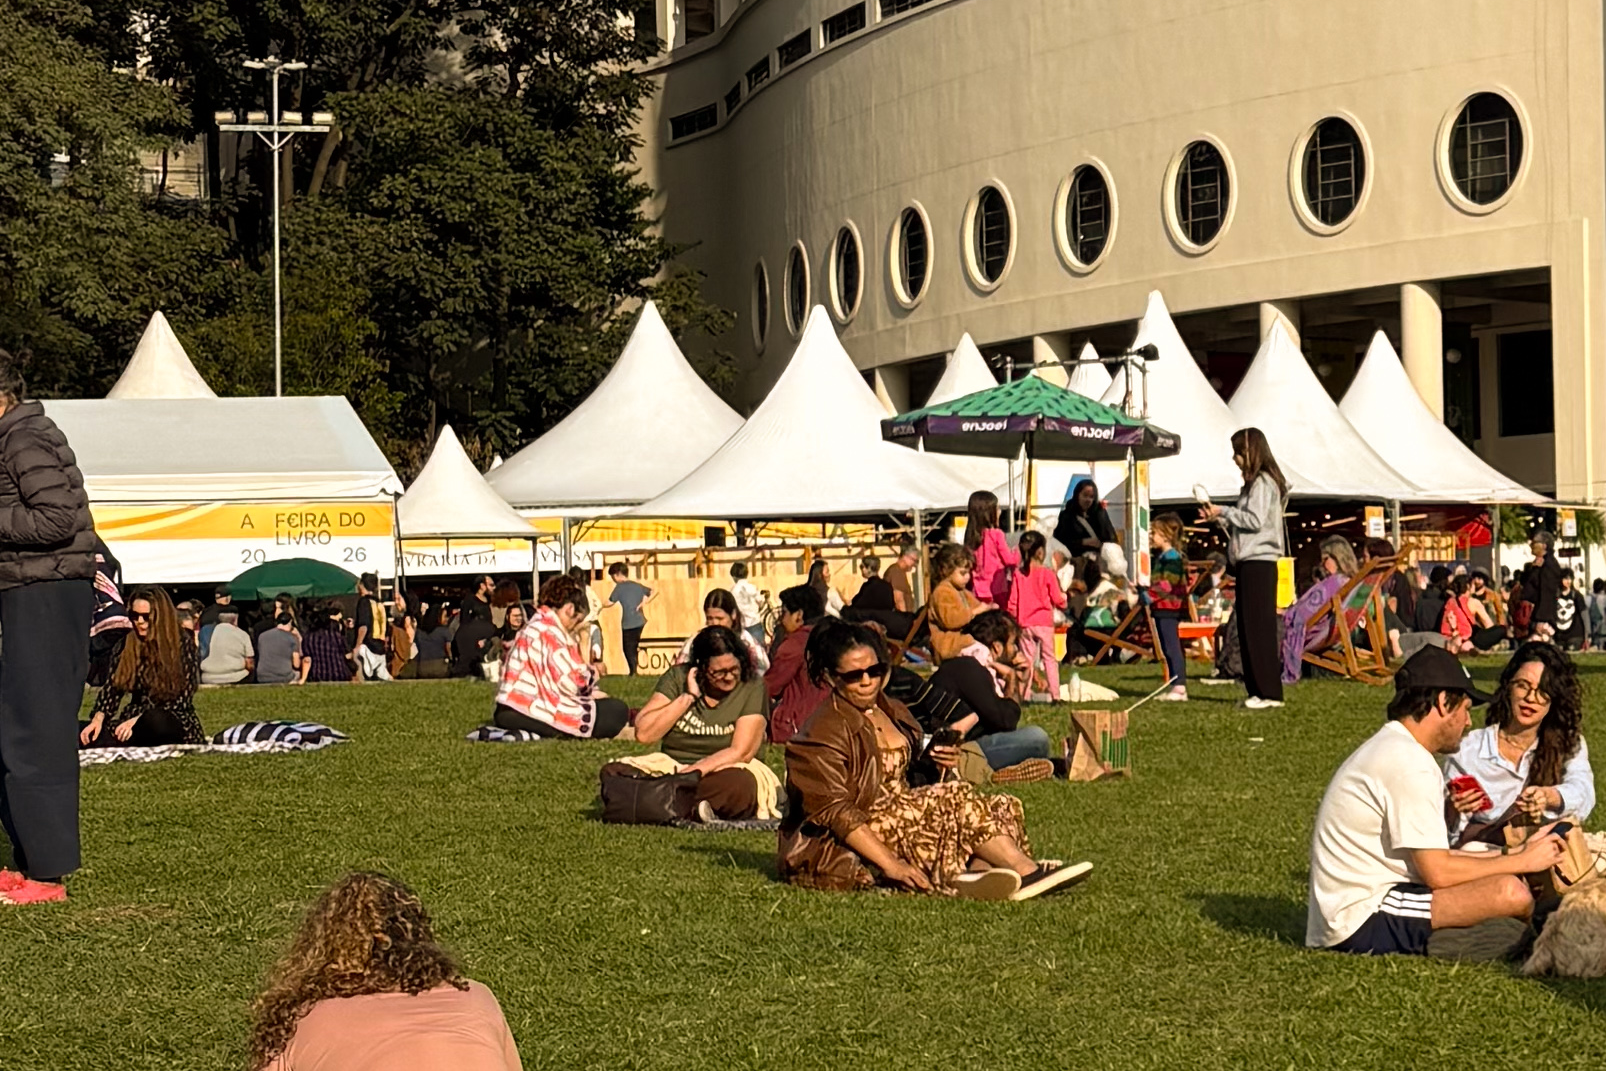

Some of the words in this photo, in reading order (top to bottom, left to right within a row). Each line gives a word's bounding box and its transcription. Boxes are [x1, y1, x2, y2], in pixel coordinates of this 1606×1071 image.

[240, 513, 255, 529] A
[275, 512, 332, 529] FEIRA
[339, 511, 366, 528] DO
[275, 529, 332, 546] LIVRO
[240, 548, 267, 564] 20
[342, 546, 367, 563] 26
